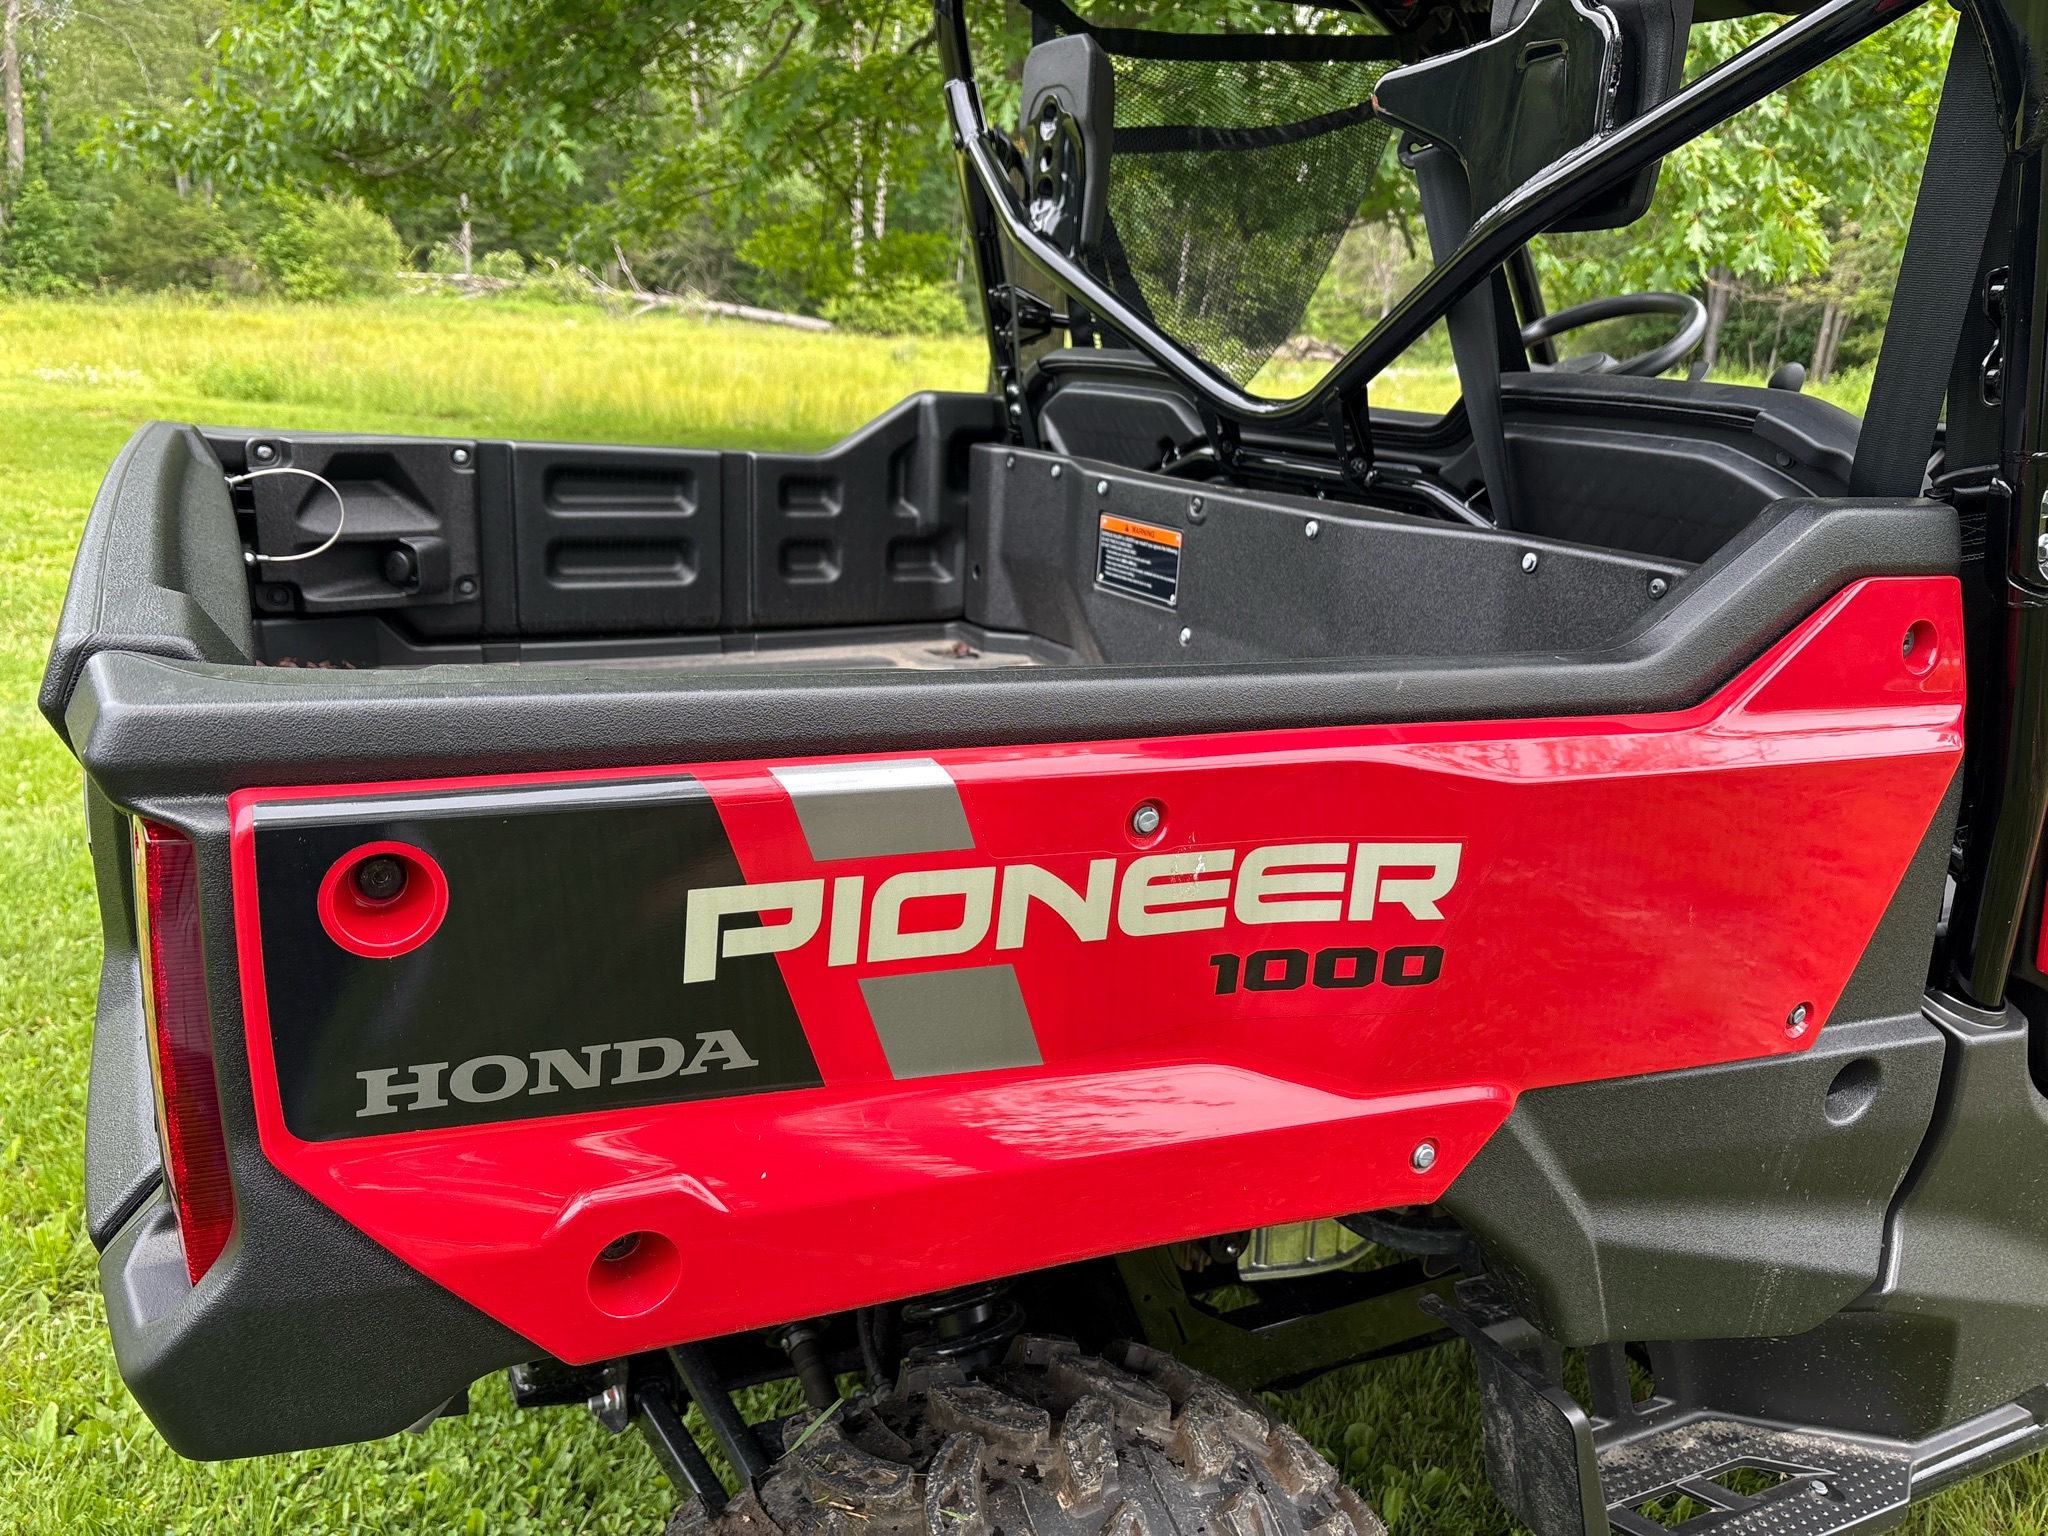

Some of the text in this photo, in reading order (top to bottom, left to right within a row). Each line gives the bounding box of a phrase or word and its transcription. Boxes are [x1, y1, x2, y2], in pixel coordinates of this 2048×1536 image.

[1131, 526, 1155, 538] WARNING
[683, 842, 1459, 984] PIONEER
[1209, 944, 1444, 996] 1000
[356, 1029, 759, 1117] HONDA
